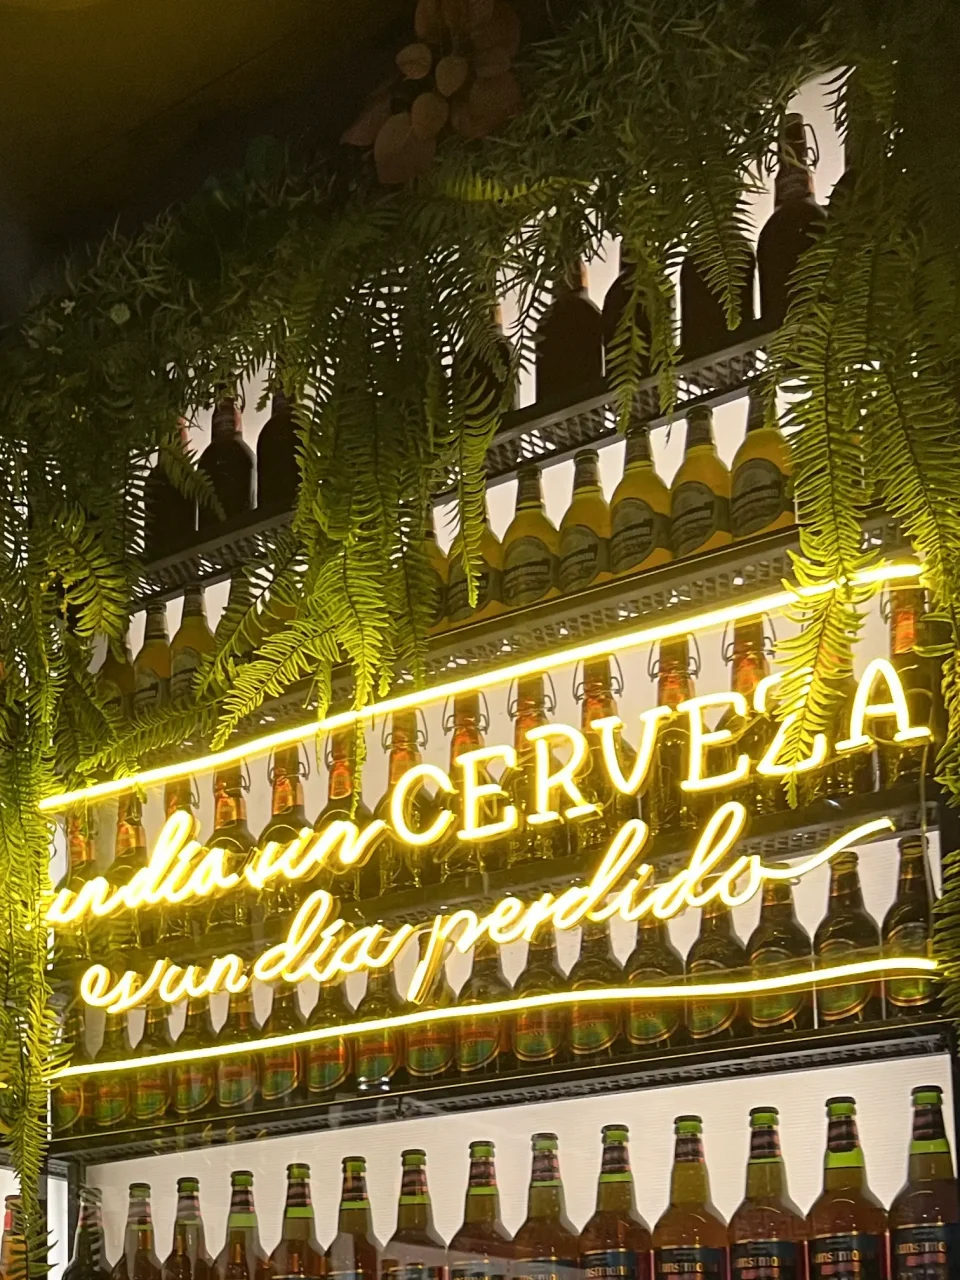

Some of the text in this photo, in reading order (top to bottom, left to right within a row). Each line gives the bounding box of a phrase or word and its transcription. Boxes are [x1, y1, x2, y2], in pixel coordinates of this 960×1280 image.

[245, 819, 388, 889] sin
[390, 657, 933, 846] CERVEZA
[407, 801, 896, 1003] perdido
